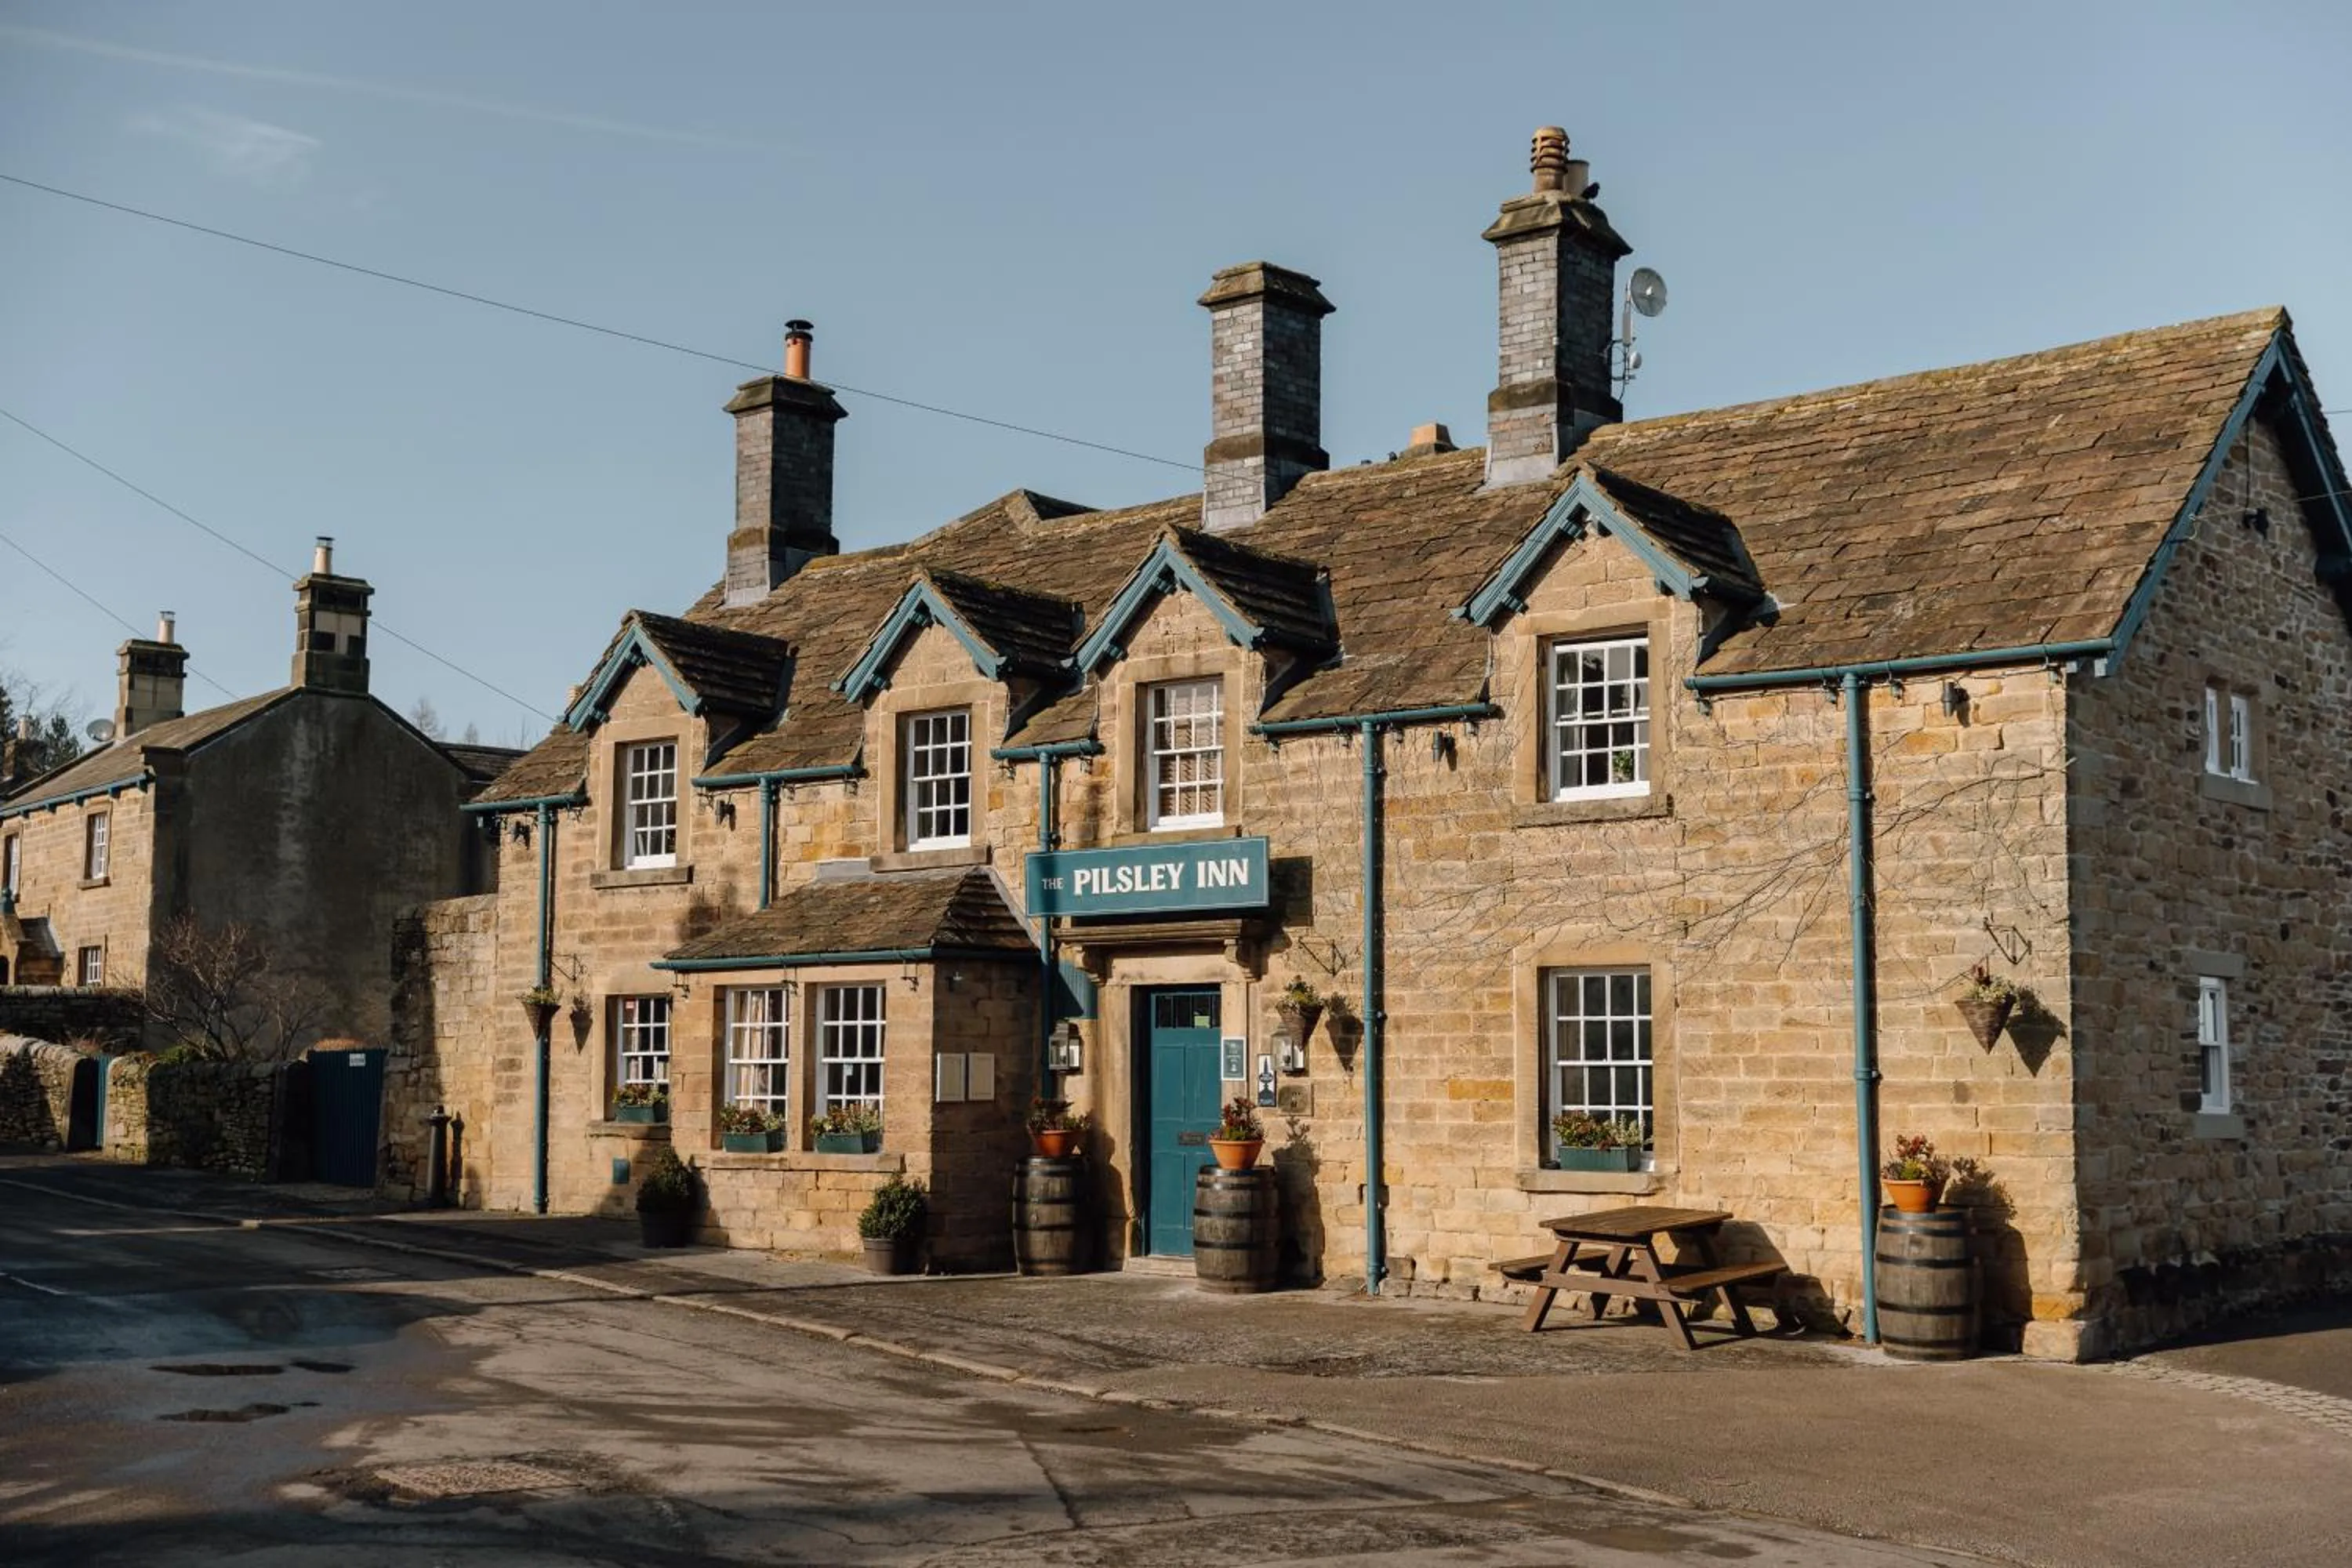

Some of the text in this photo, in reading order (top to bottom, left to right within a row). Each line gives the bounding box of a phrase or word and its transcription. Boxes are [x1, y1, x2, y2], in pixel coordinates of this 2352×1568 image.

[1041, 858, 1249, 895] THE PILSLEY INN
